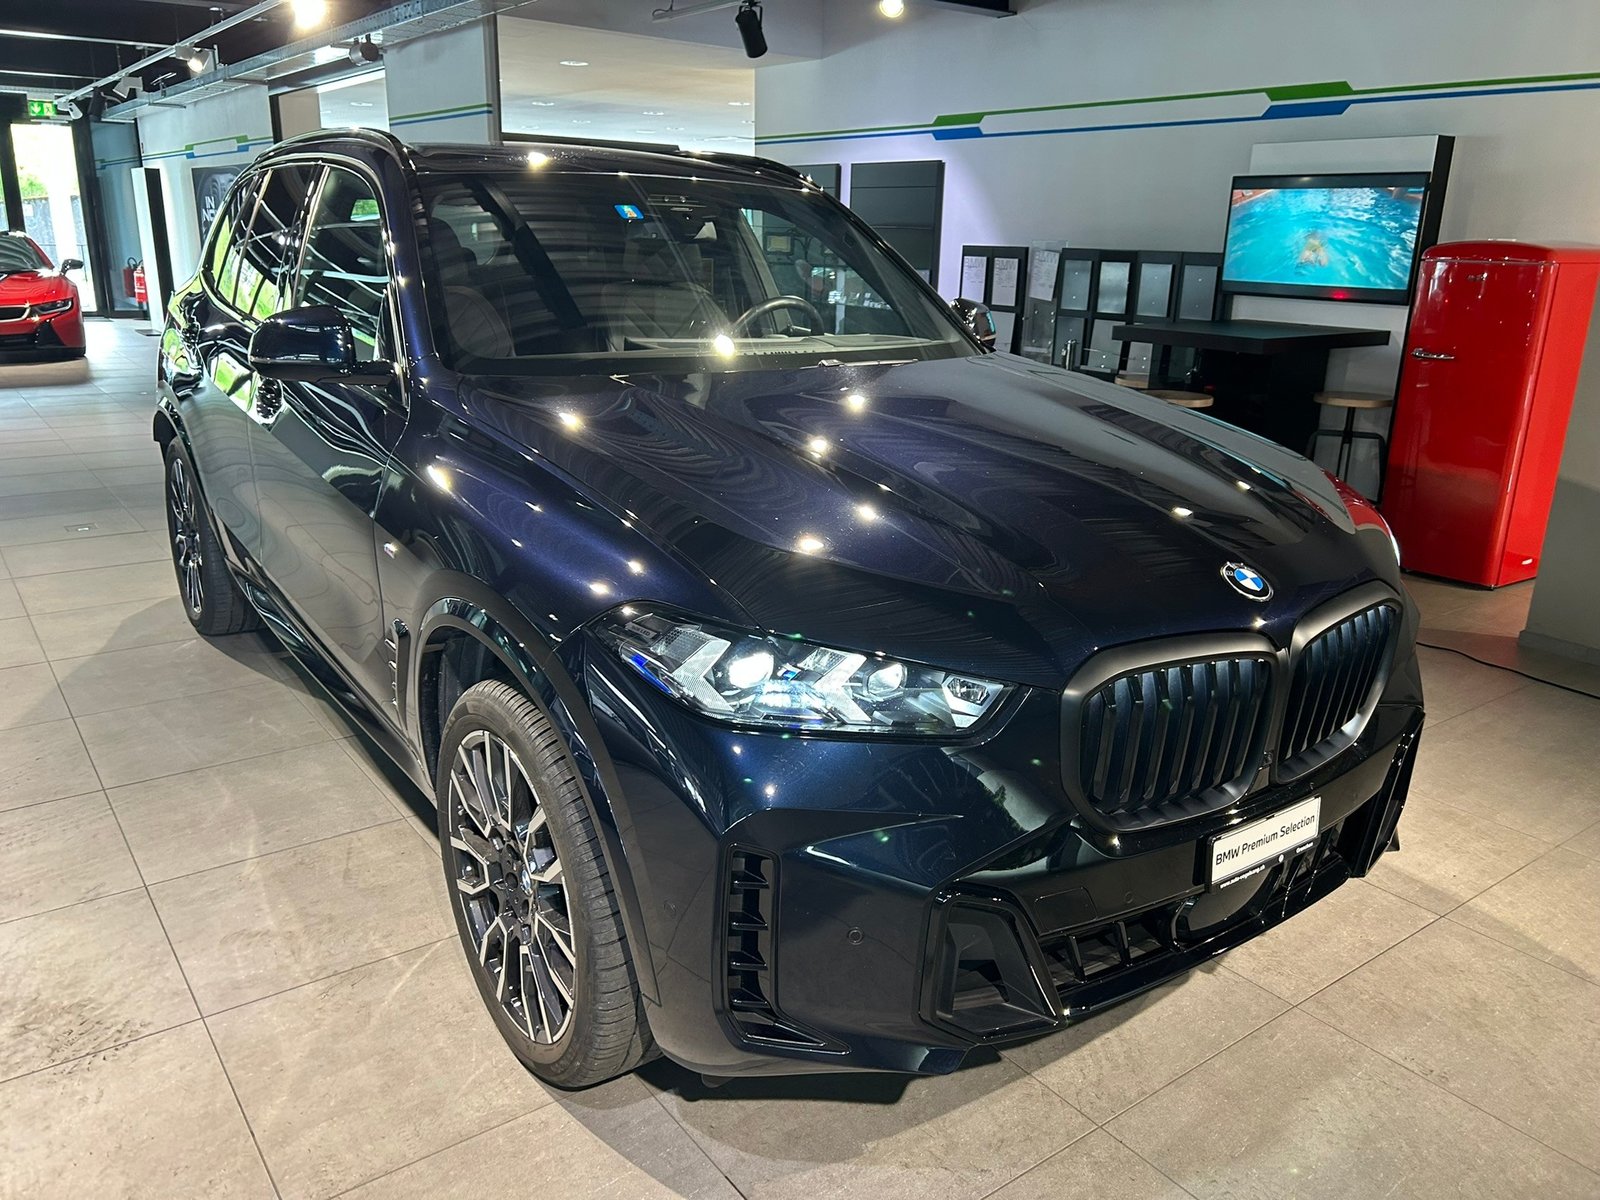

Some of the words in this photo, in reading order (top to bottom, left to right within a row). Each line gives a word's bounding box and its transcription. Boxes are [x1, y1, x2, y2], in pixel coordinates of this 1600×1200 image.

[1216, 846, 1240, 865] BMW
[1241, 831, 1278, 854] Premium
[1280, 815, 1315, 837] Selection
